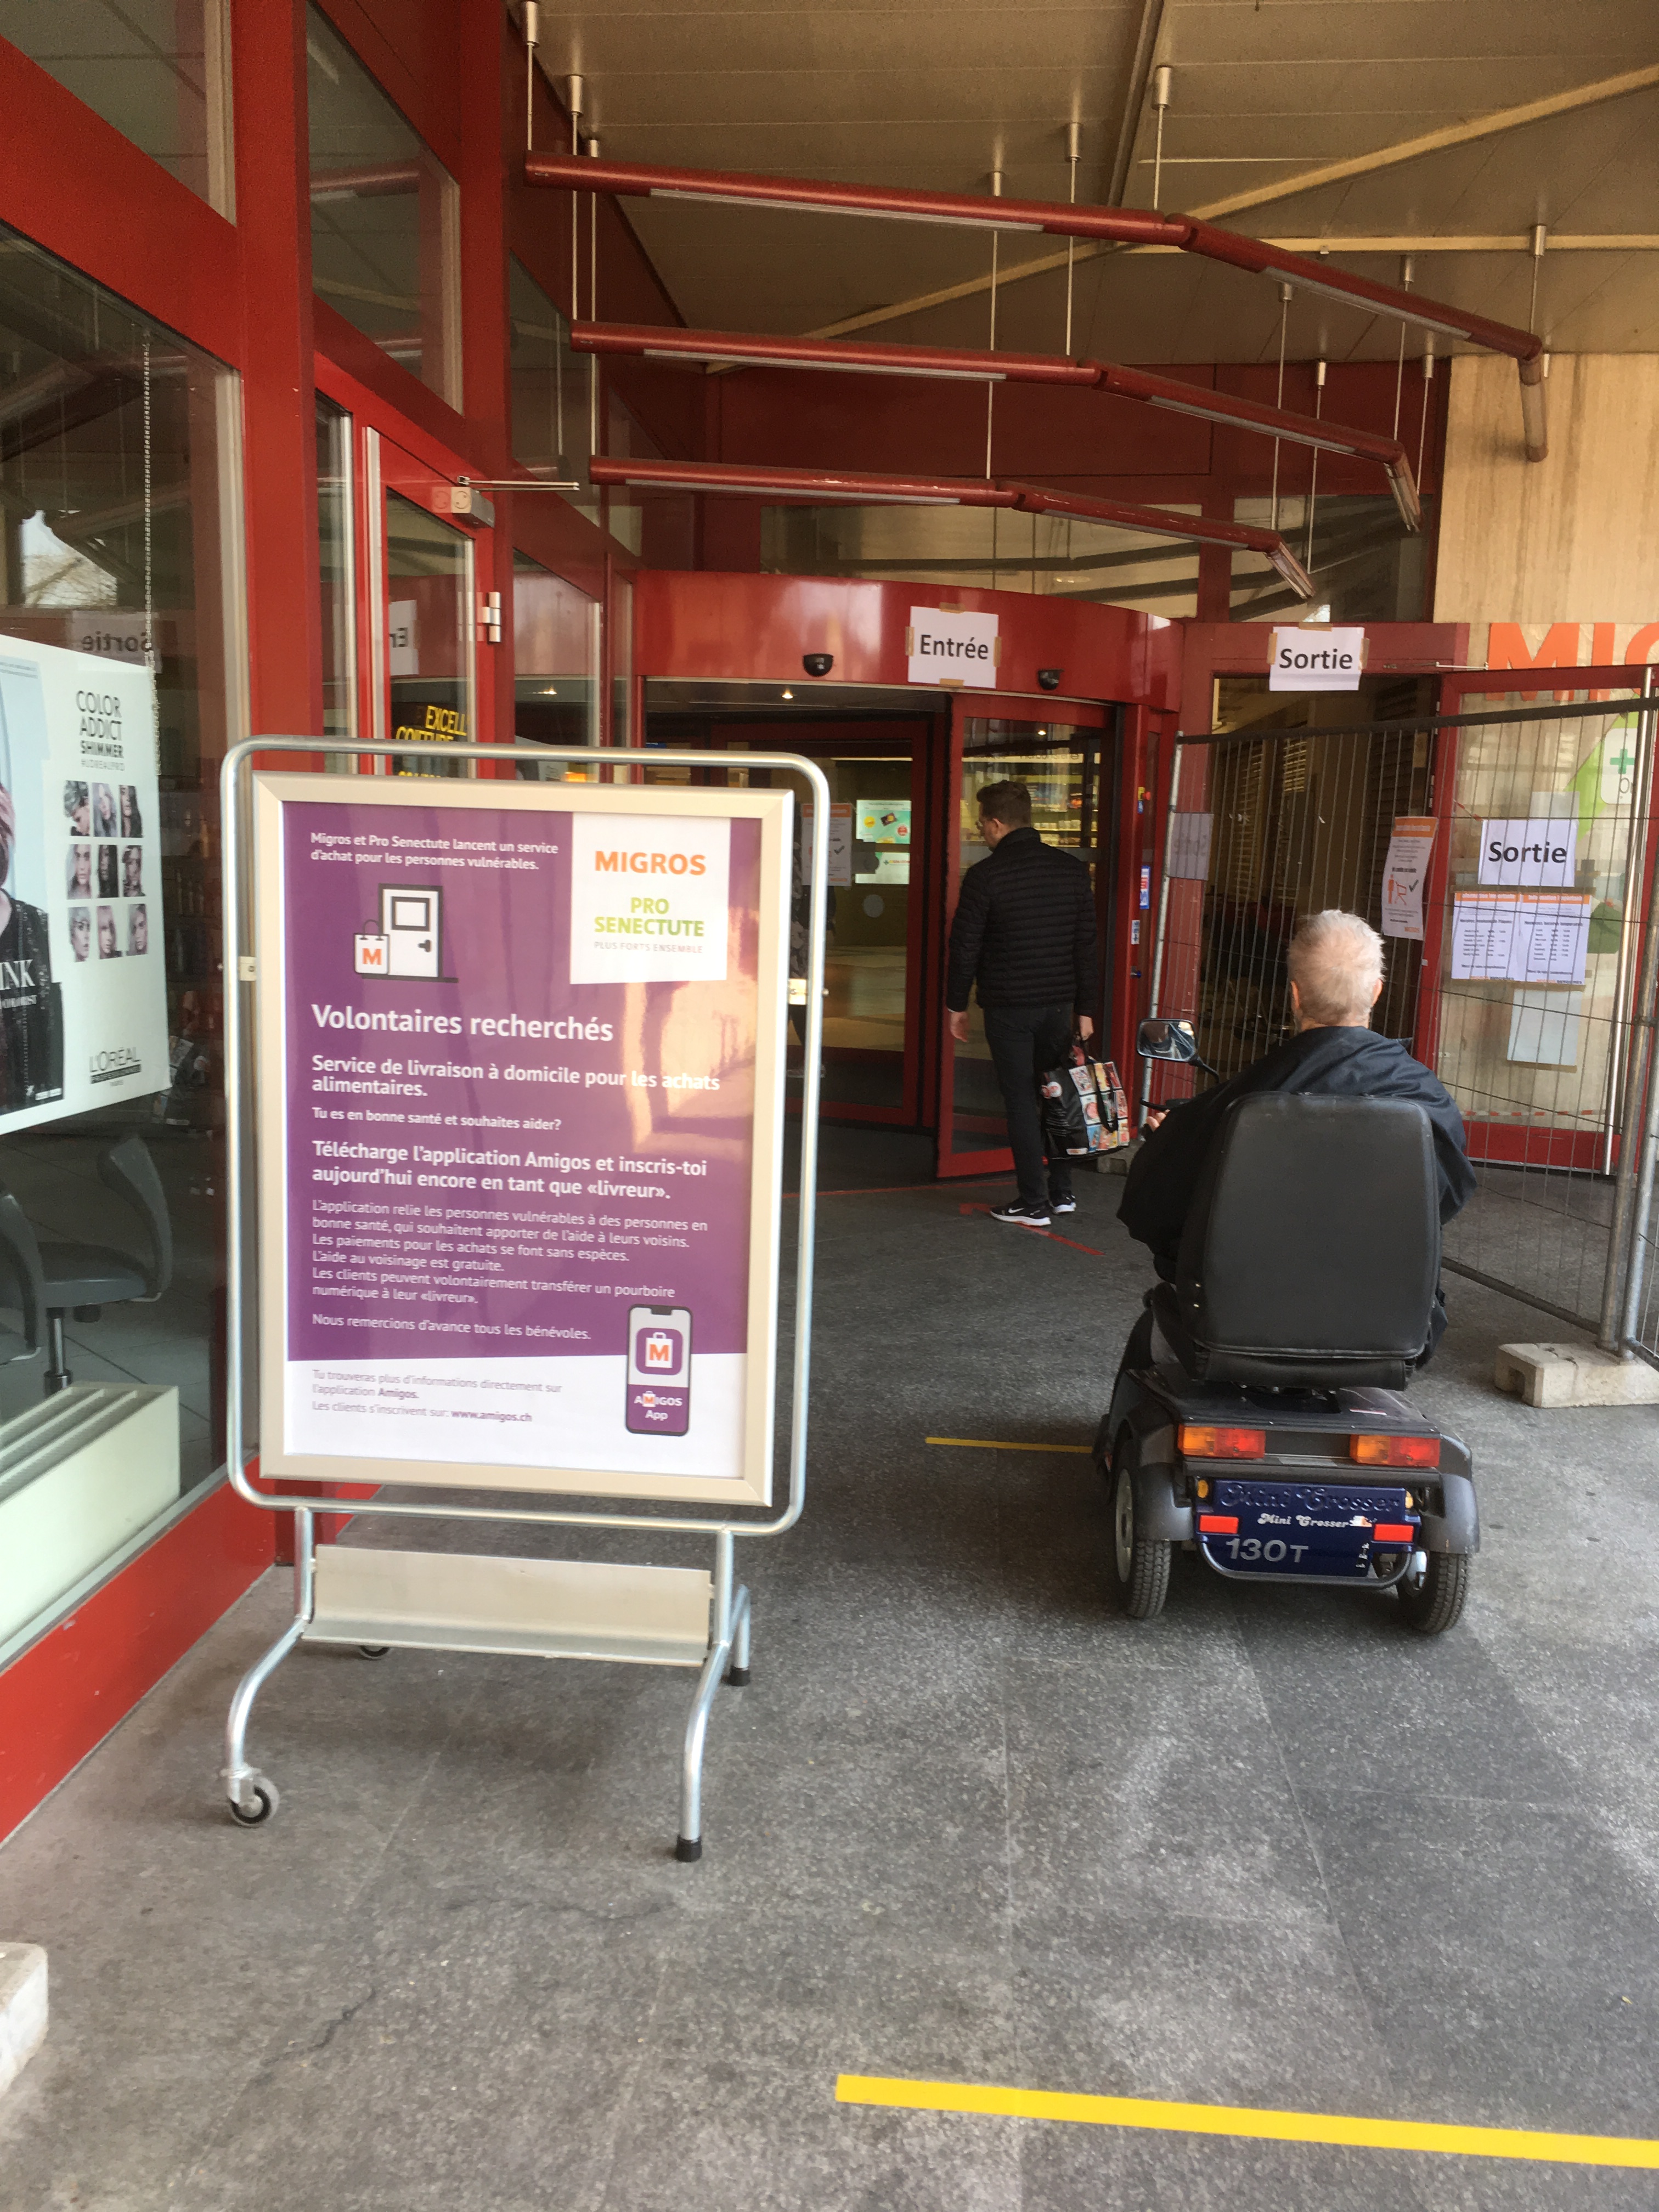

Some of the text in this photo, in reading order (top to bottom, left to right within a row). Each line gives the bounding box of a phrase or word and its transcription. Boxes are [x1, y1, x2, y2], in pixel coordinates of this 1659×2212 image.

[921, 634, 989, 660] Entrée
[1279, 648, 1353, 669] Sortie
[76, 690, 122, 718] COLOR
[79, 716, 122, 741] ADDICT
[311, 832, 558, 854] Migros et Pro Senectute lancent un service
[1488, 842, 1567, 864] Sortie
[355, 854, 383, 865] pour
[385, 853, 403, 864] les
[405, 856, 465, 866] personnes
[467, 857, 539, 870] vulnérables.
[595, 850, 707, 876] MIGROS
[630, 897, 670, 915] PRO
[594, 916, 705, 936] SENECTUTE
[594, 941, 703, 953] PLUS FORTS ENSEMBLE
[311, 1004, 614, 1042] Volontaires recherchés
[312, 1054, 720, 1091] Service de livraison à domicile pour les achats
[312, 1076, 427, 1096] alimentaires.
[312, 1107, 561, 1130] Tu es en bonne santé et souhaites aider?
[312, 1140, 707, 1176] Télécharge l'application Amigos et inscris-toi
[312, 1166, 670, 1199] aujourd'hui encore en tant que «livreur».
[393, 1204, 421, 1216] relie
[425, 1205, 443, 1217] les
[445, 1209, 509, 1221] personnes
[512, 1211, 585, 1224] vulnérables
[588, 1214, 596, 1225] à
[599, 1215, 621, 1227] des
[624, 1218, 689, 1230] personnes
[691, 1222, 708, 1231] en
[313, 1216, 352, 1229] bonne
[354, 1220, 392, 1233] santé,
[393, 1222, 414, 1234] qui
[417, 1223, 483, 1237] souhaitent
[486, 1228, 540, 1240] apporter
[543, 1229, 558, 1240] de
[597, 1231, 606, 1243] à
[609, 1232, 640, 1245] leurs
[643, 1234, 690, 1248] voisins.
[313, 1233, 629, 1262] Les paiements pour les achats se font sans espèces.
[349, 1255, 365, 1263] au
[368, 1254, 427, 1269] voisinage
[430, 1259, 450, 1268] est
[452, 1260, 504, 1272] gratuite.
[313, 1267, 675, 1297] Les clients peuvent volontairement transférer un pourboire
[313, 1285, 379, 1300] numérique
[381, 1287, 390, 1299] à
[393, 1288, 418, 1300] leur
[313, 1313, 345, 1326] Nous
[347, 1318, 415, 1330] remercions
[473, 1324, 501, 1334] tous
[504, 1324, 523, 1336] les
[526, 1325, 591, 1339] bénévoles.
[312, 1369, 325, 1379] Tu
[327, 1372, 376, 1382] trouveras
[379, 1374, 401, 1384] plus
[479, 1379, 544, 1392] directement
[377, 1387, 420, 1400] Amigos.
[313, 1401, 330, 1410] Les
[332, 1402, 366, 1413] clients
[451, 1410, 532, 1423] www.amigos.ch
[645, 1410, 668, 1421] App
